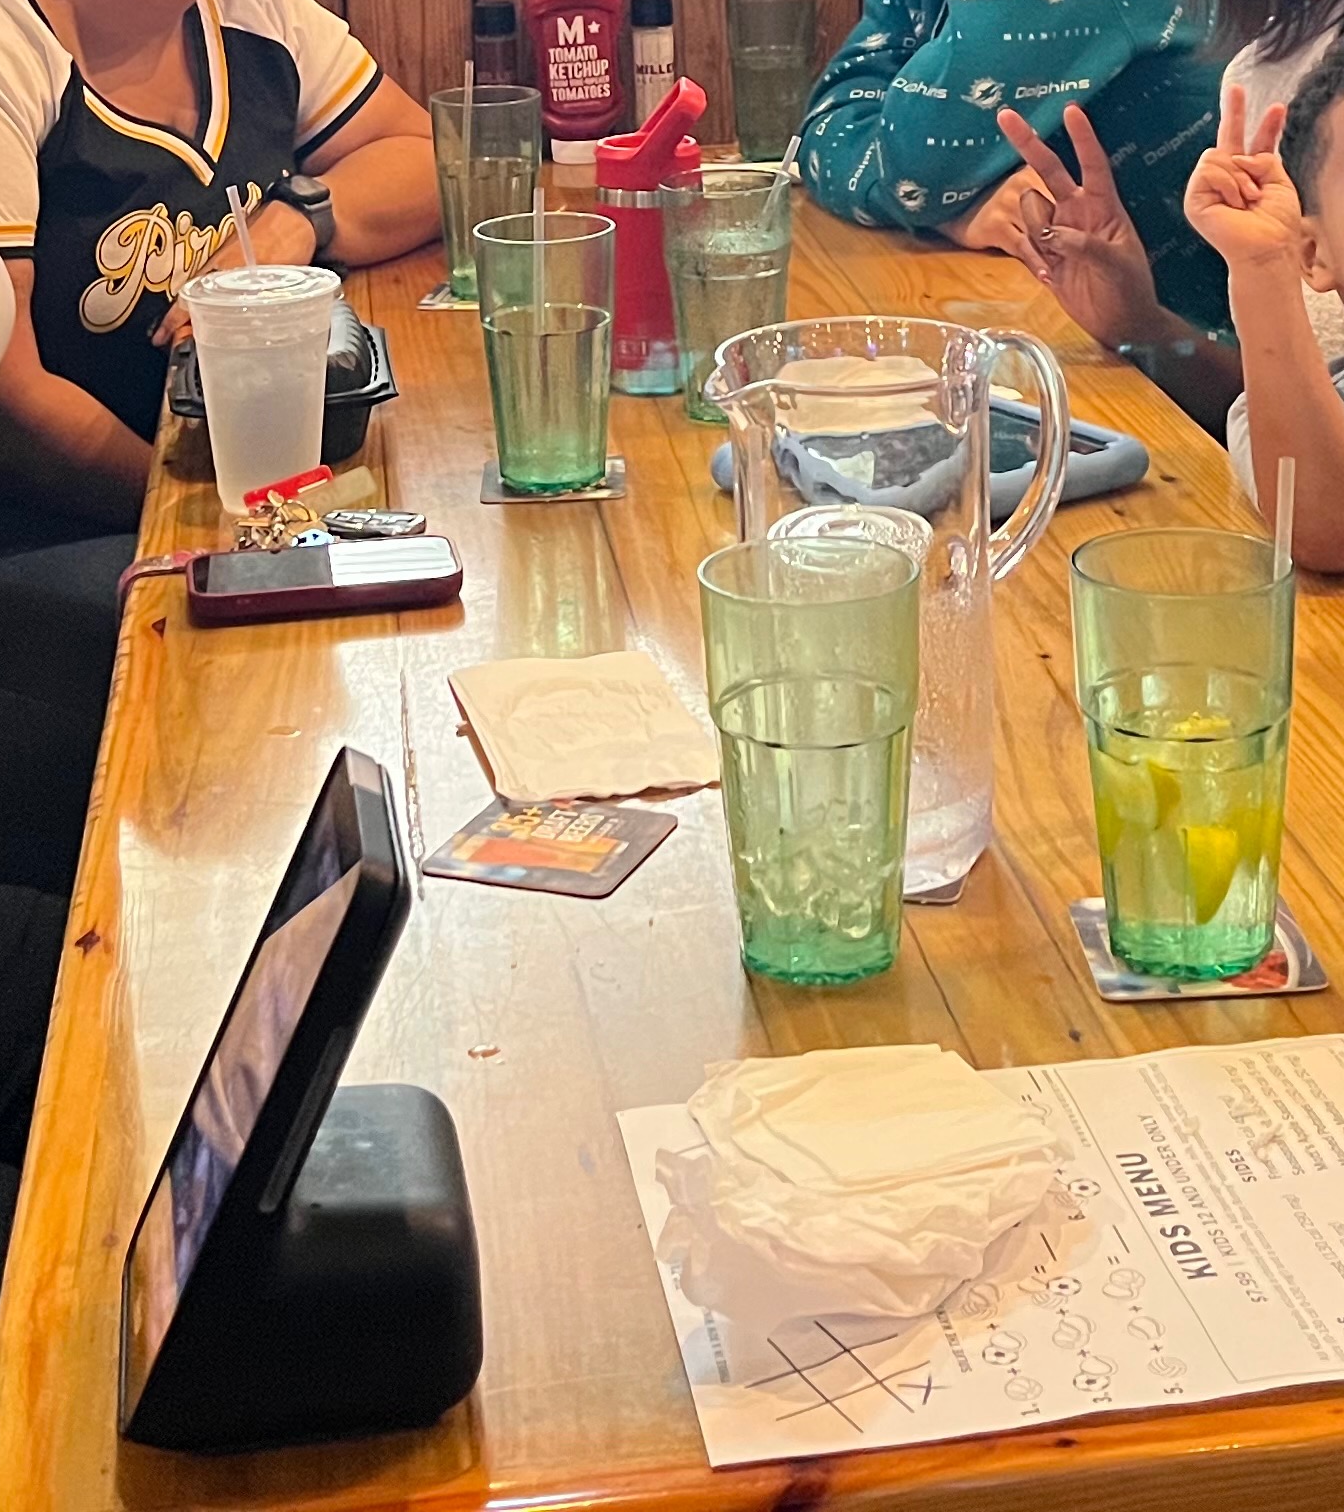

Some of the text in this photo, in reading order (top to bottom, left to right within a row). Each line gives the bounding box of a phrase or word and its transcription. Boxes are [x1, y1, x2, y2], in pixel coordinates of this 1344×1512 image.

[557, 16, 585, 46] M
[549, 45, 598, 63] TOMATO
[549, 59, 609, 80] KETCHUP
[552, 83, 611, 101] TOMATOES
[1014, 78, 1091, 100] Dolphins
[1135, 1113, 1168, 1142] ONLY
[1154, 1145, 1193, 1183] UNDER
[1222, 1148, 1259, 1182] SIDES
[1113, 1151, 1181, 1217] MENU
[1178, 1184, 1208, 1209] AND
[1195, 1211, 1219, 1226] 12
[1156, 1223, 1218, 1279] KIDS
[1205, 1228, 1239, 1257] KIDS
[1232, 1270, 1269, 1303] $7.99
